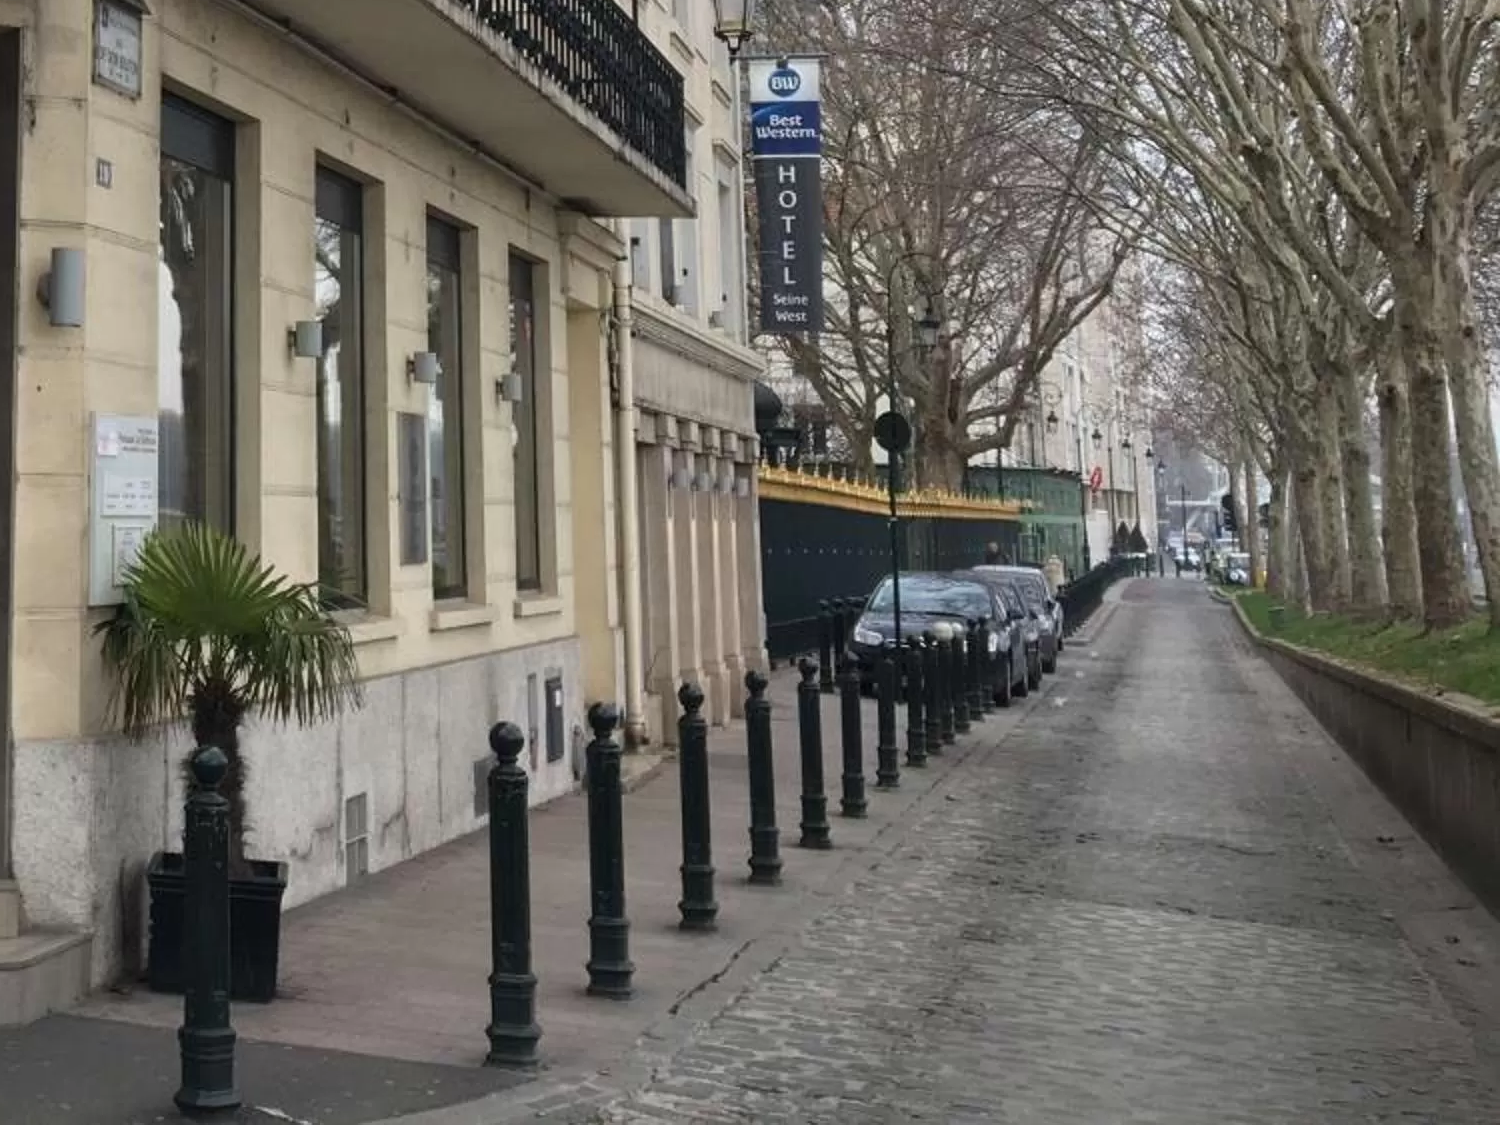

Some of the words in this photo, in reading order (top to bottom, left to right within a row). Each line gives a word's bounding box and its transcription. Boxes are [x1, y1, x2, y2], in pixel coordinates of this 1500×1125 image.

[771, 74, 800, 91] BW
[769, 114, 803, 126] Best
[777, 165, 798, 285] HOTEL
[773, 293, 809, 306] Seine
[775, 310, 808, 323] West
